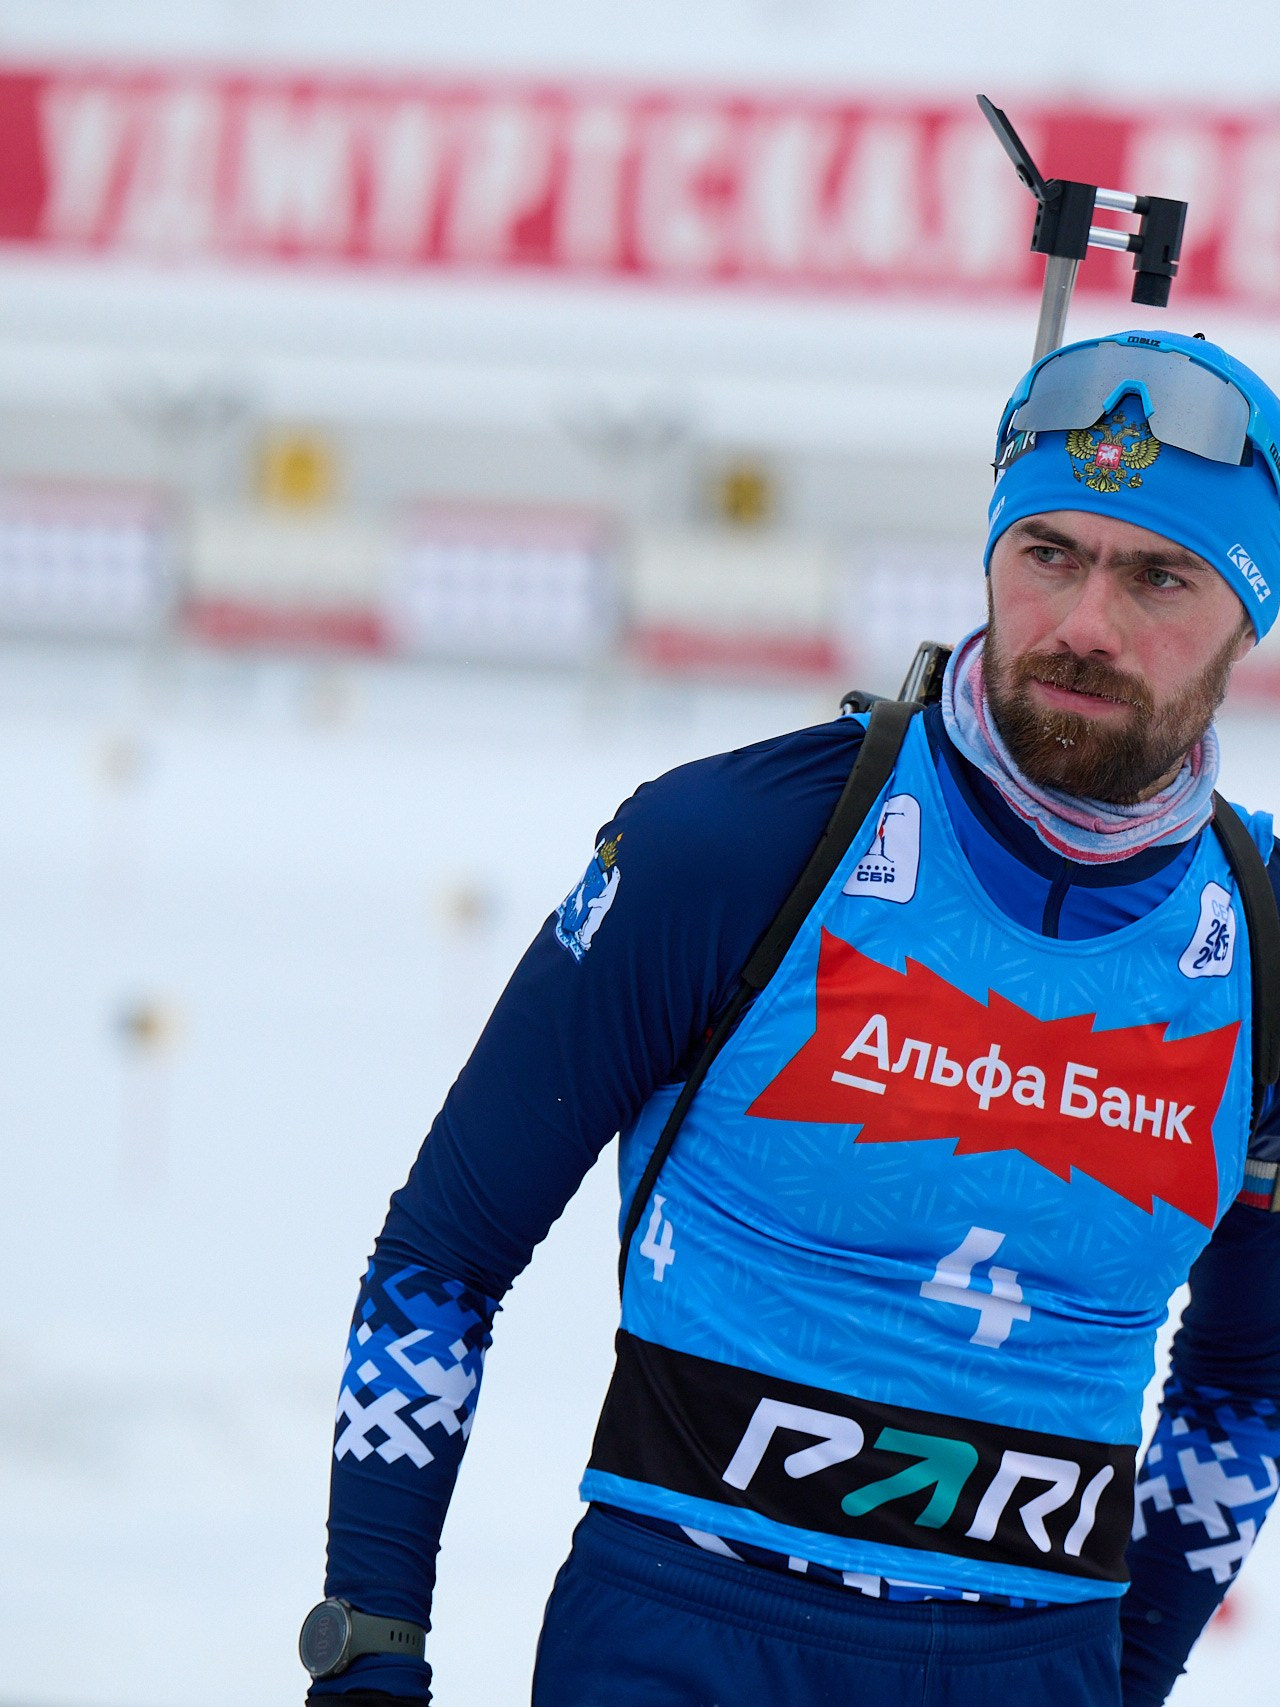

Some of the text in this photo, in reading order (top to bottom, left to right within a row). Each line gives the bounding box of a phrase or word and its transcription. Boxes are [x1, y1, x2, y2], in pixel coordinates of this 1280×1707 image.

[38, 84, 1043, 290] УДМУРТСКАЯ
[857, 872, 895, 883] СБР
[840, 1014, 1196, 1144] Альфа Банк
[640, 1194, 676, 1283] 4
[919, 1226, 1031, 1349] 4
[722, 1397, 1114, 1557] PARI
